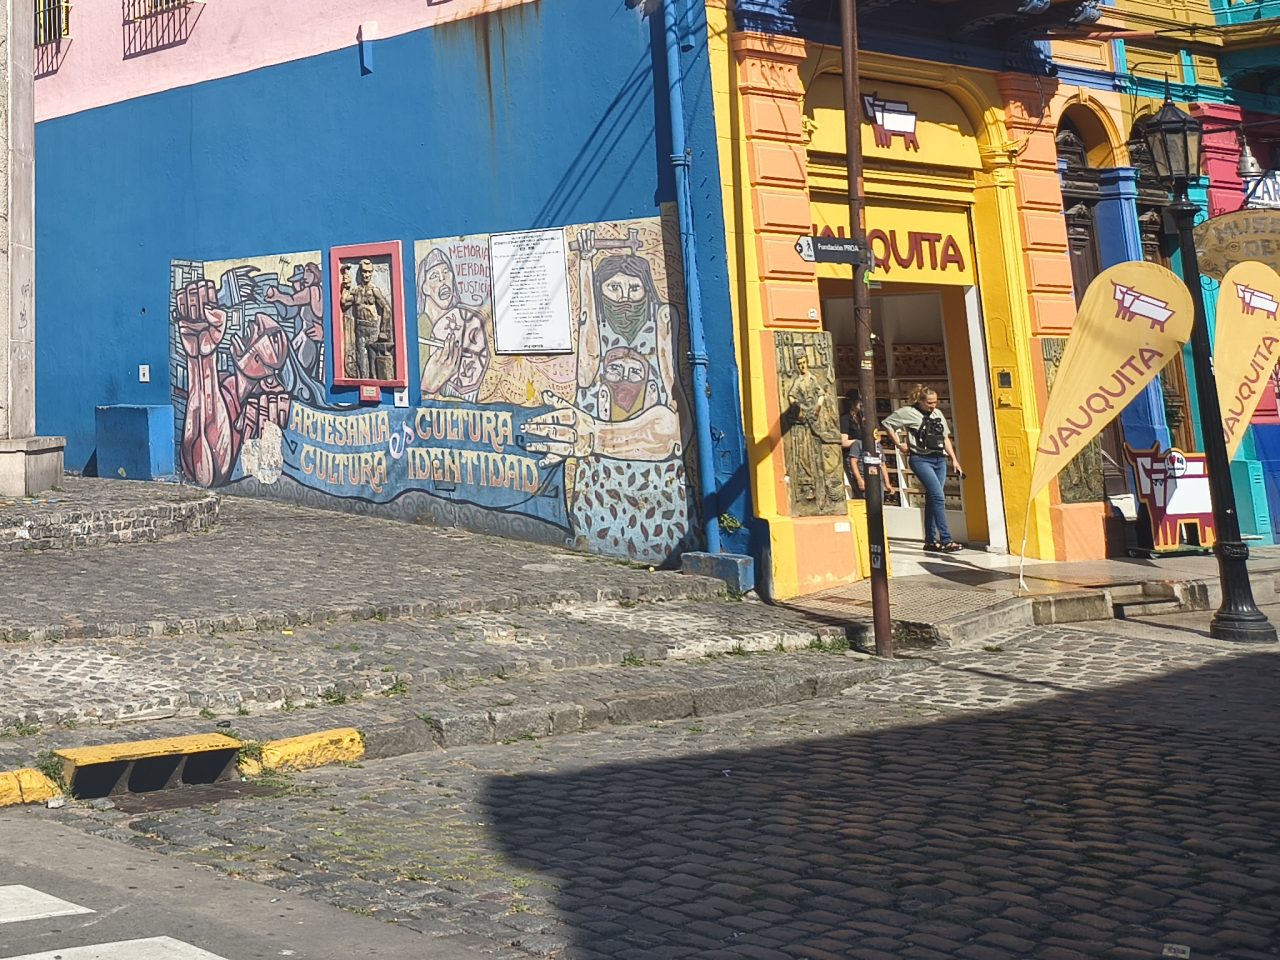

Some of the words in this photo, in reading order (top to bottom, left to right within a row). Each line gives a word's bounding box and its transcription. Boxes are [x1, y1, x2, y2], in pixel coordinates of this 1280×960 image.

[449, 245, 489, 260] MEMORIA
[843, 244, 859, 252] PROA
[455, 263, 490, 278] VERDAD
[1038, 347, 1163, 456] VAUQUITA
[289, 401, 390, 446] ARTESANIA
[415, 407, 514, 453] CULTURA
[300, 442, 388, 493] CULTURA
[406, 447, 539, 493] IDENTIDAD
